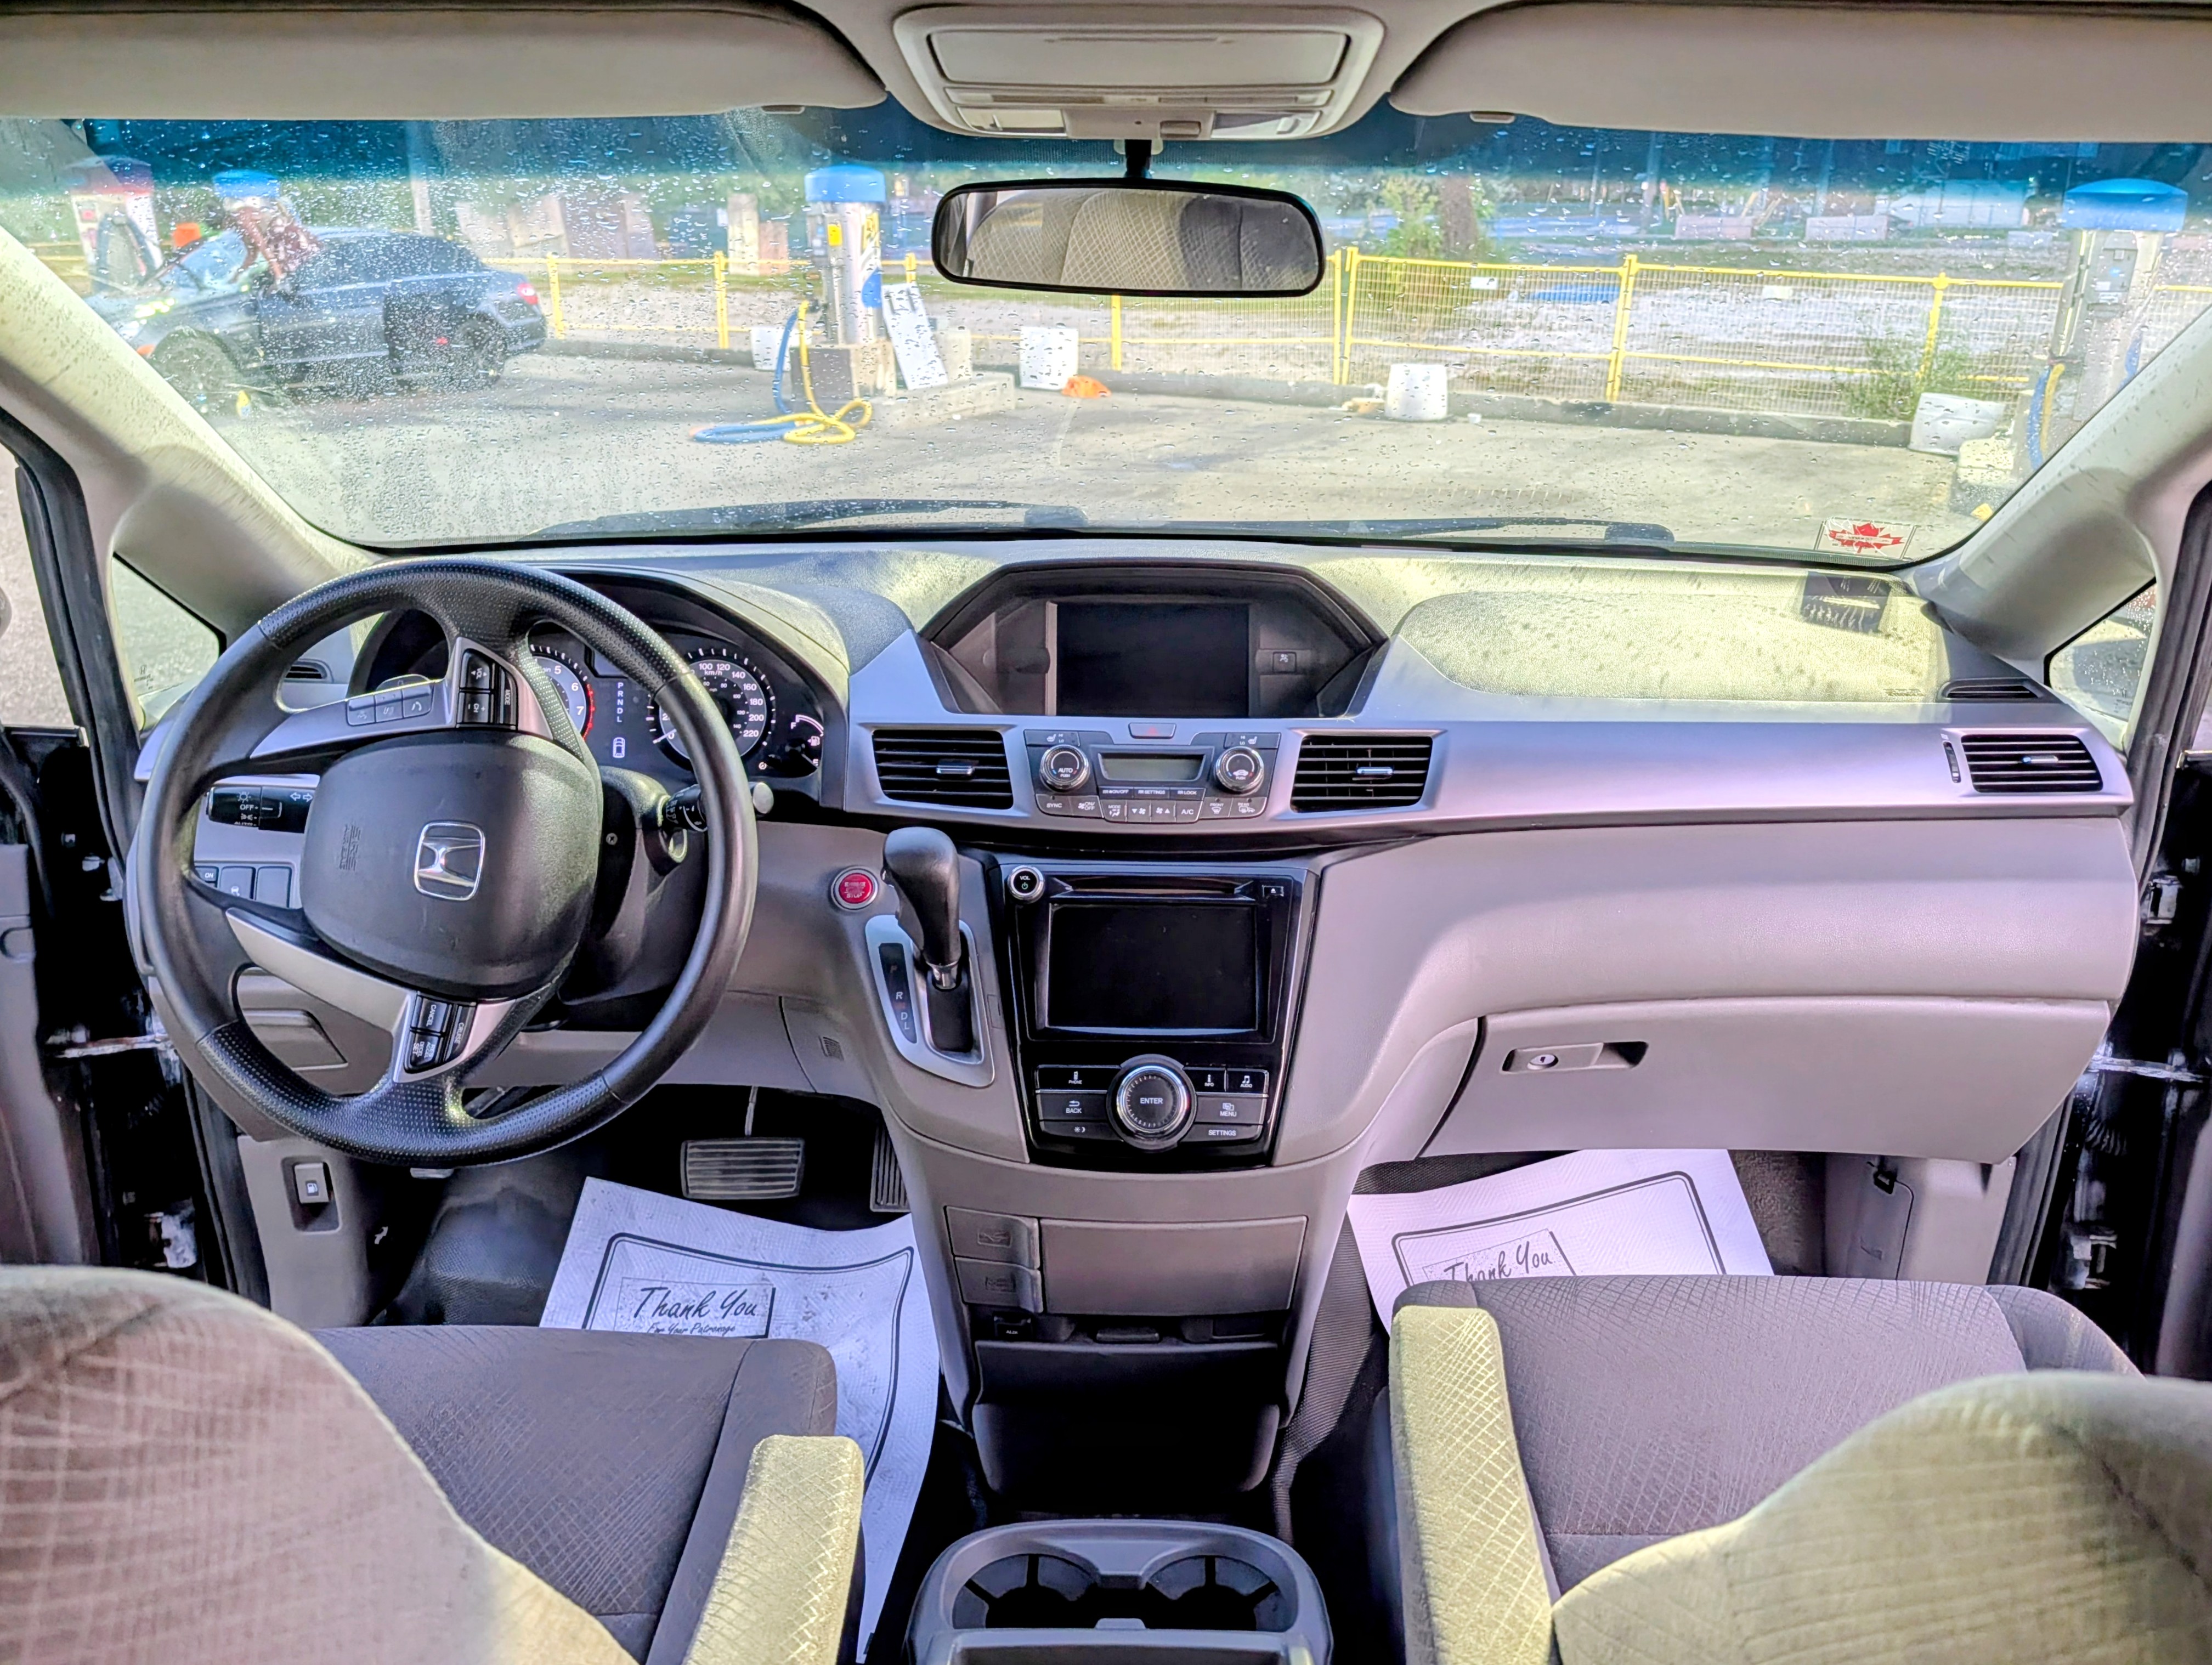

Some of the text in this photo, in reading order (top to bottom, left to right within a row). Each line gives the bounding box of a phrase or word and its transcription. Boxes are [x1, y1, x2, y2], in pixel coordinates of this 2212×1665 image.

[554, 666, 562, 675] 5
[571, 682, 579, 691] 6
[473, 703, 480, 713] CH
[576, 706, 584, 715] 7
[896, 992, 903, 1000] R
[426, 1004, 437, 1027] CANCEL
[901, 1012, 908, 1020] D
[904, 1022, 909, 1030] L
[454, 1022, 465, 1044] CRUISE
[1516, 1241, 1553, 1274] You
[633, 1287, 756, 1319] Thank You
[647, 1322, 736, 1336] For Your Patronage
